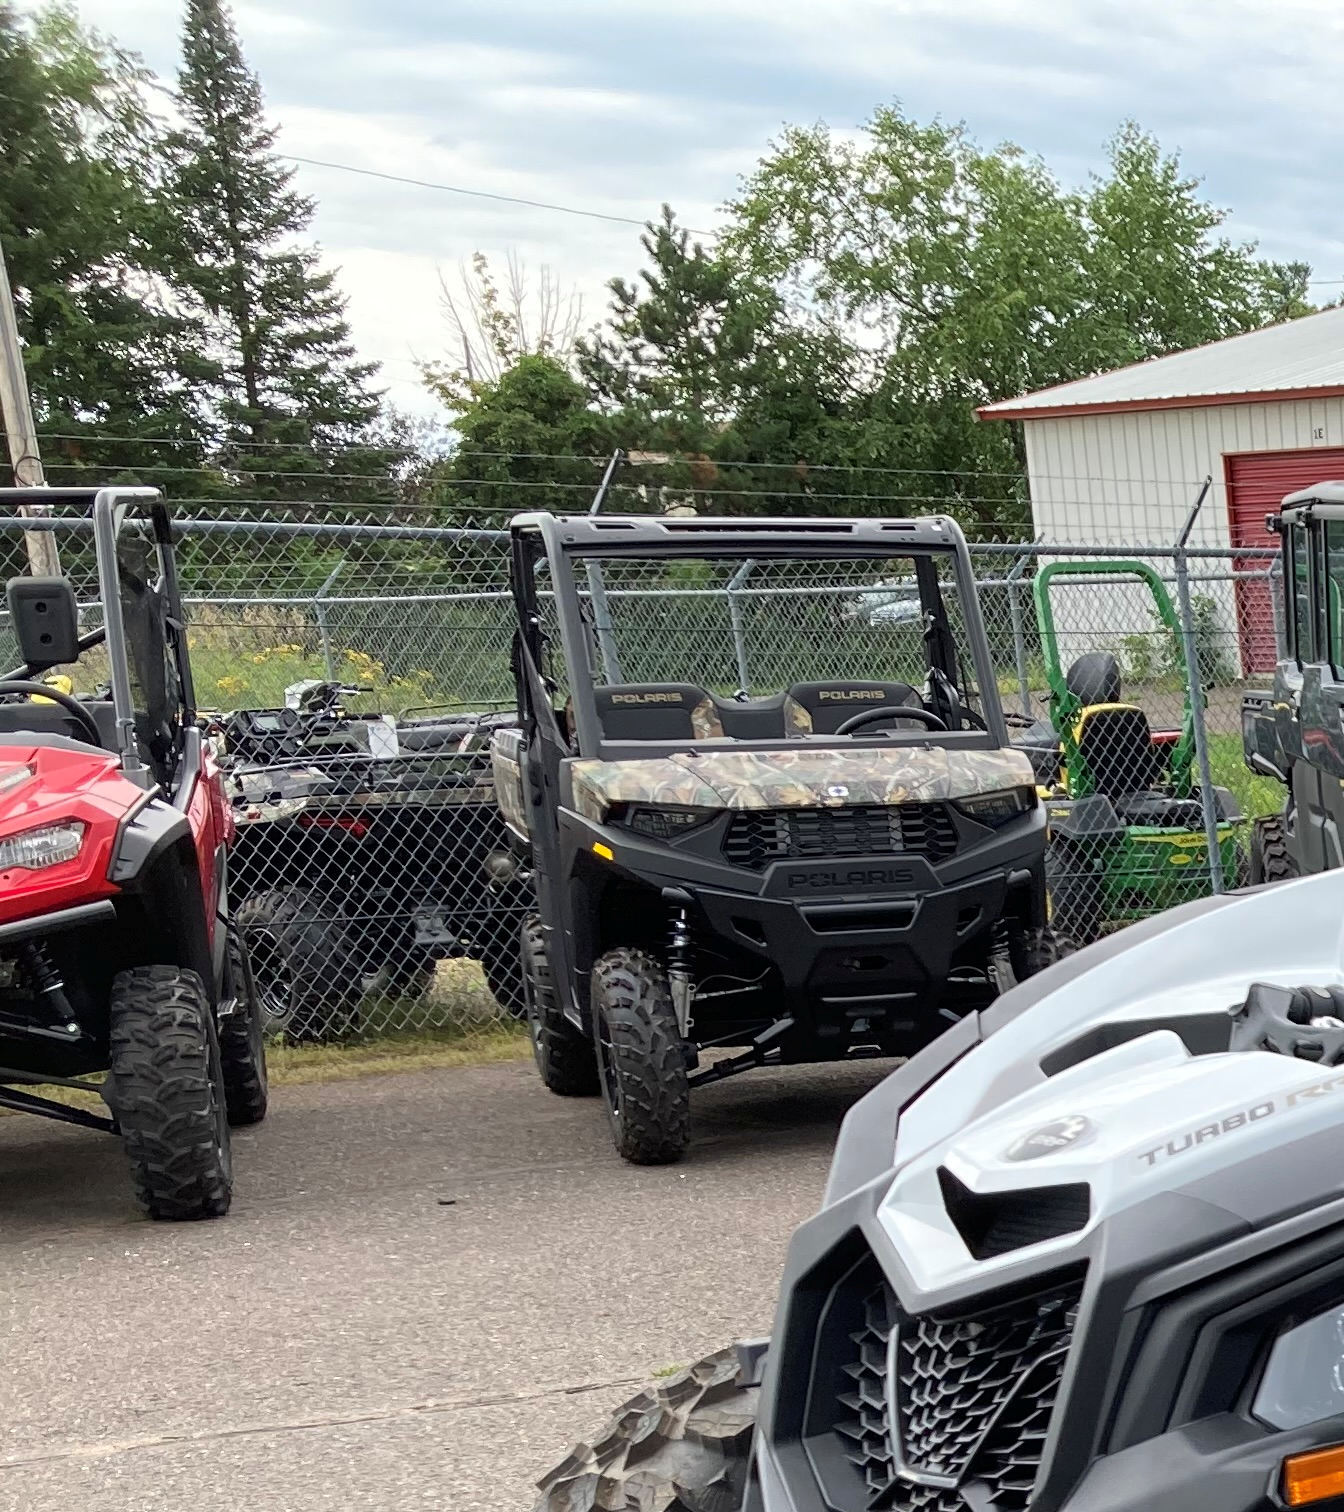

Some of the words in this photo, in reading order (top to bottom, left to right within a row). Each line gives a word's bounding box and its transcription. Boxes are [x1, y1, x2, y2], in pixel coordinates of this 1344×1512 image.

[1313, 428, 1324, 440] 1E
[611, 692, 683, 704] POLARIS
[818, 689, 886, 701] POLARIS
[787, 868, 914, 889] POLARIS
[1138, 1101, 1276, 1166] TURBO
